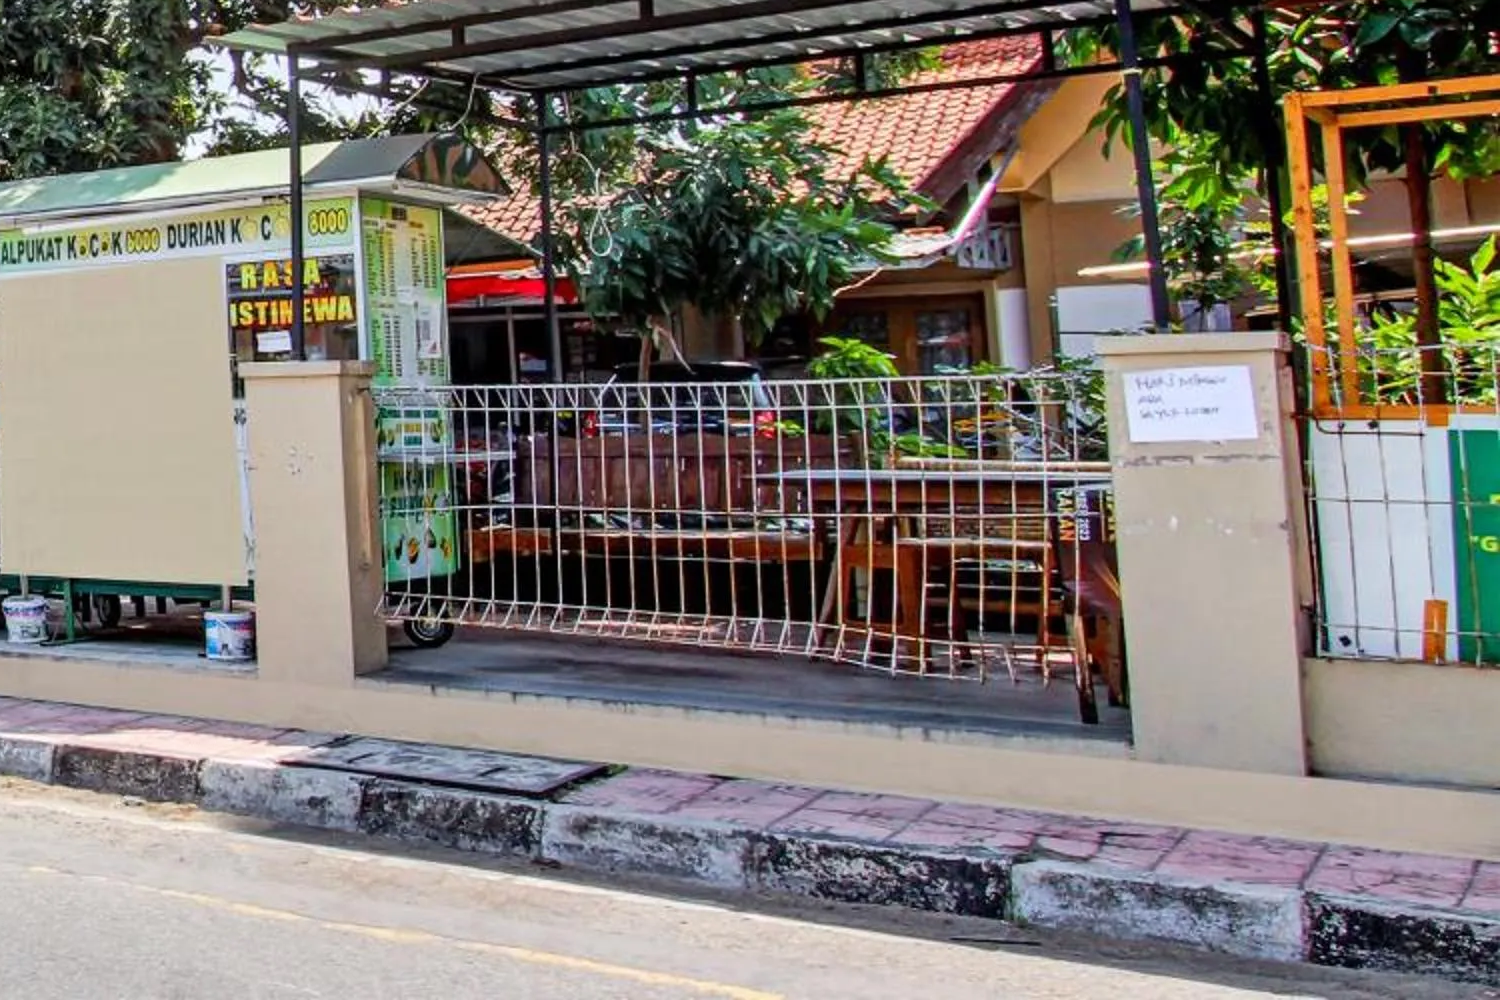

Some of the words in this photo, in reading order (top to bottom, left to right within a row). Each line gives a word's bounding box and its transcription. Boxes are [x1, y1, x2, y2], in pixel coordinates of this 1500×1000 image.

[1, 237, 63, 264] ALPUKAT
[167, 220, 225, 249] DURIAN
[240, 258, 321, 289] RASA
